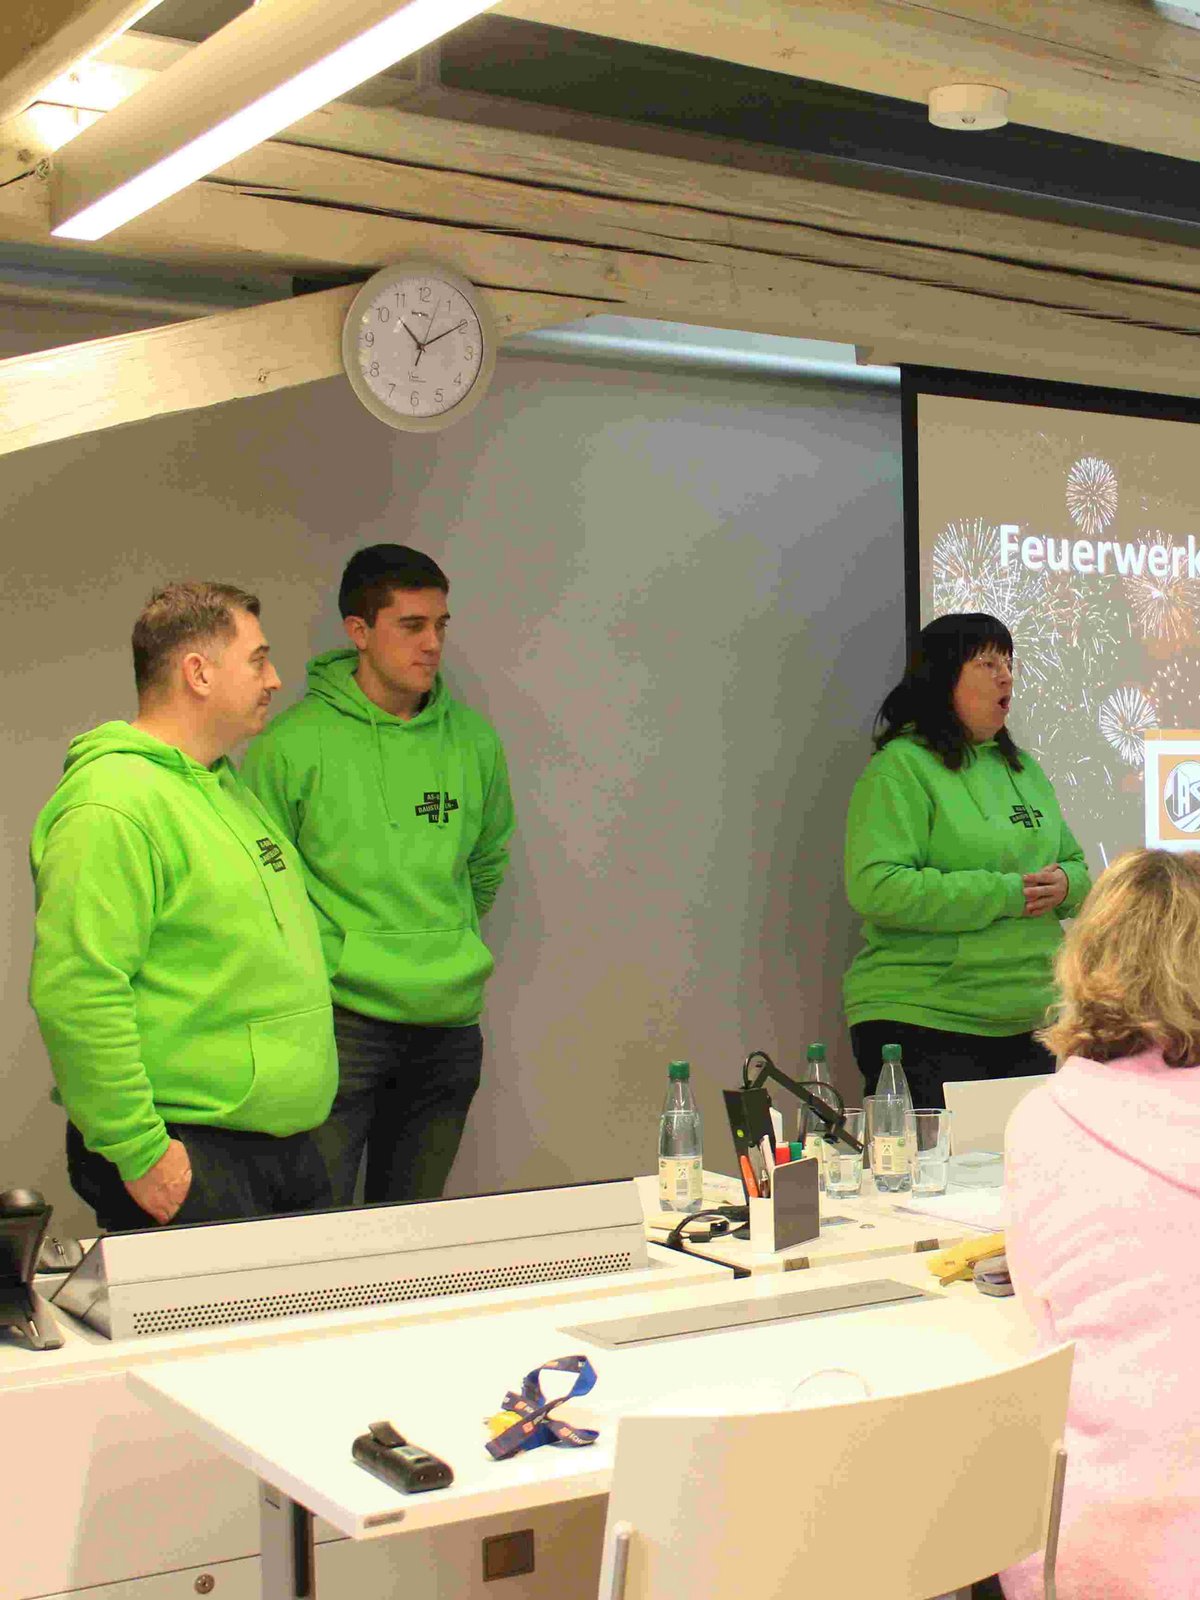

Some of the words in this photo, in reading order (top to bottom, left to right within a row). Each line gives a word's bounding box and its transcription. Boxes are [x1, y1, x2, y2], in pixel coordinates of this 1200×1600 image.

[394, 292, 406, 308] 11
[418, 286, 432, 302] 12
[375, 306, 390, 323] 10
[458, 318, 469, 334] 2
[364, 331, 375, 348] 9
[463, 345, 473, 361] 3
[369, 361, 380, 377] 8
[453, 372, 462, 387] 4
[388, 383, 396, 398] 7
[410, 390, 420, 407] 6
[434, 388, 444, 403] 5
